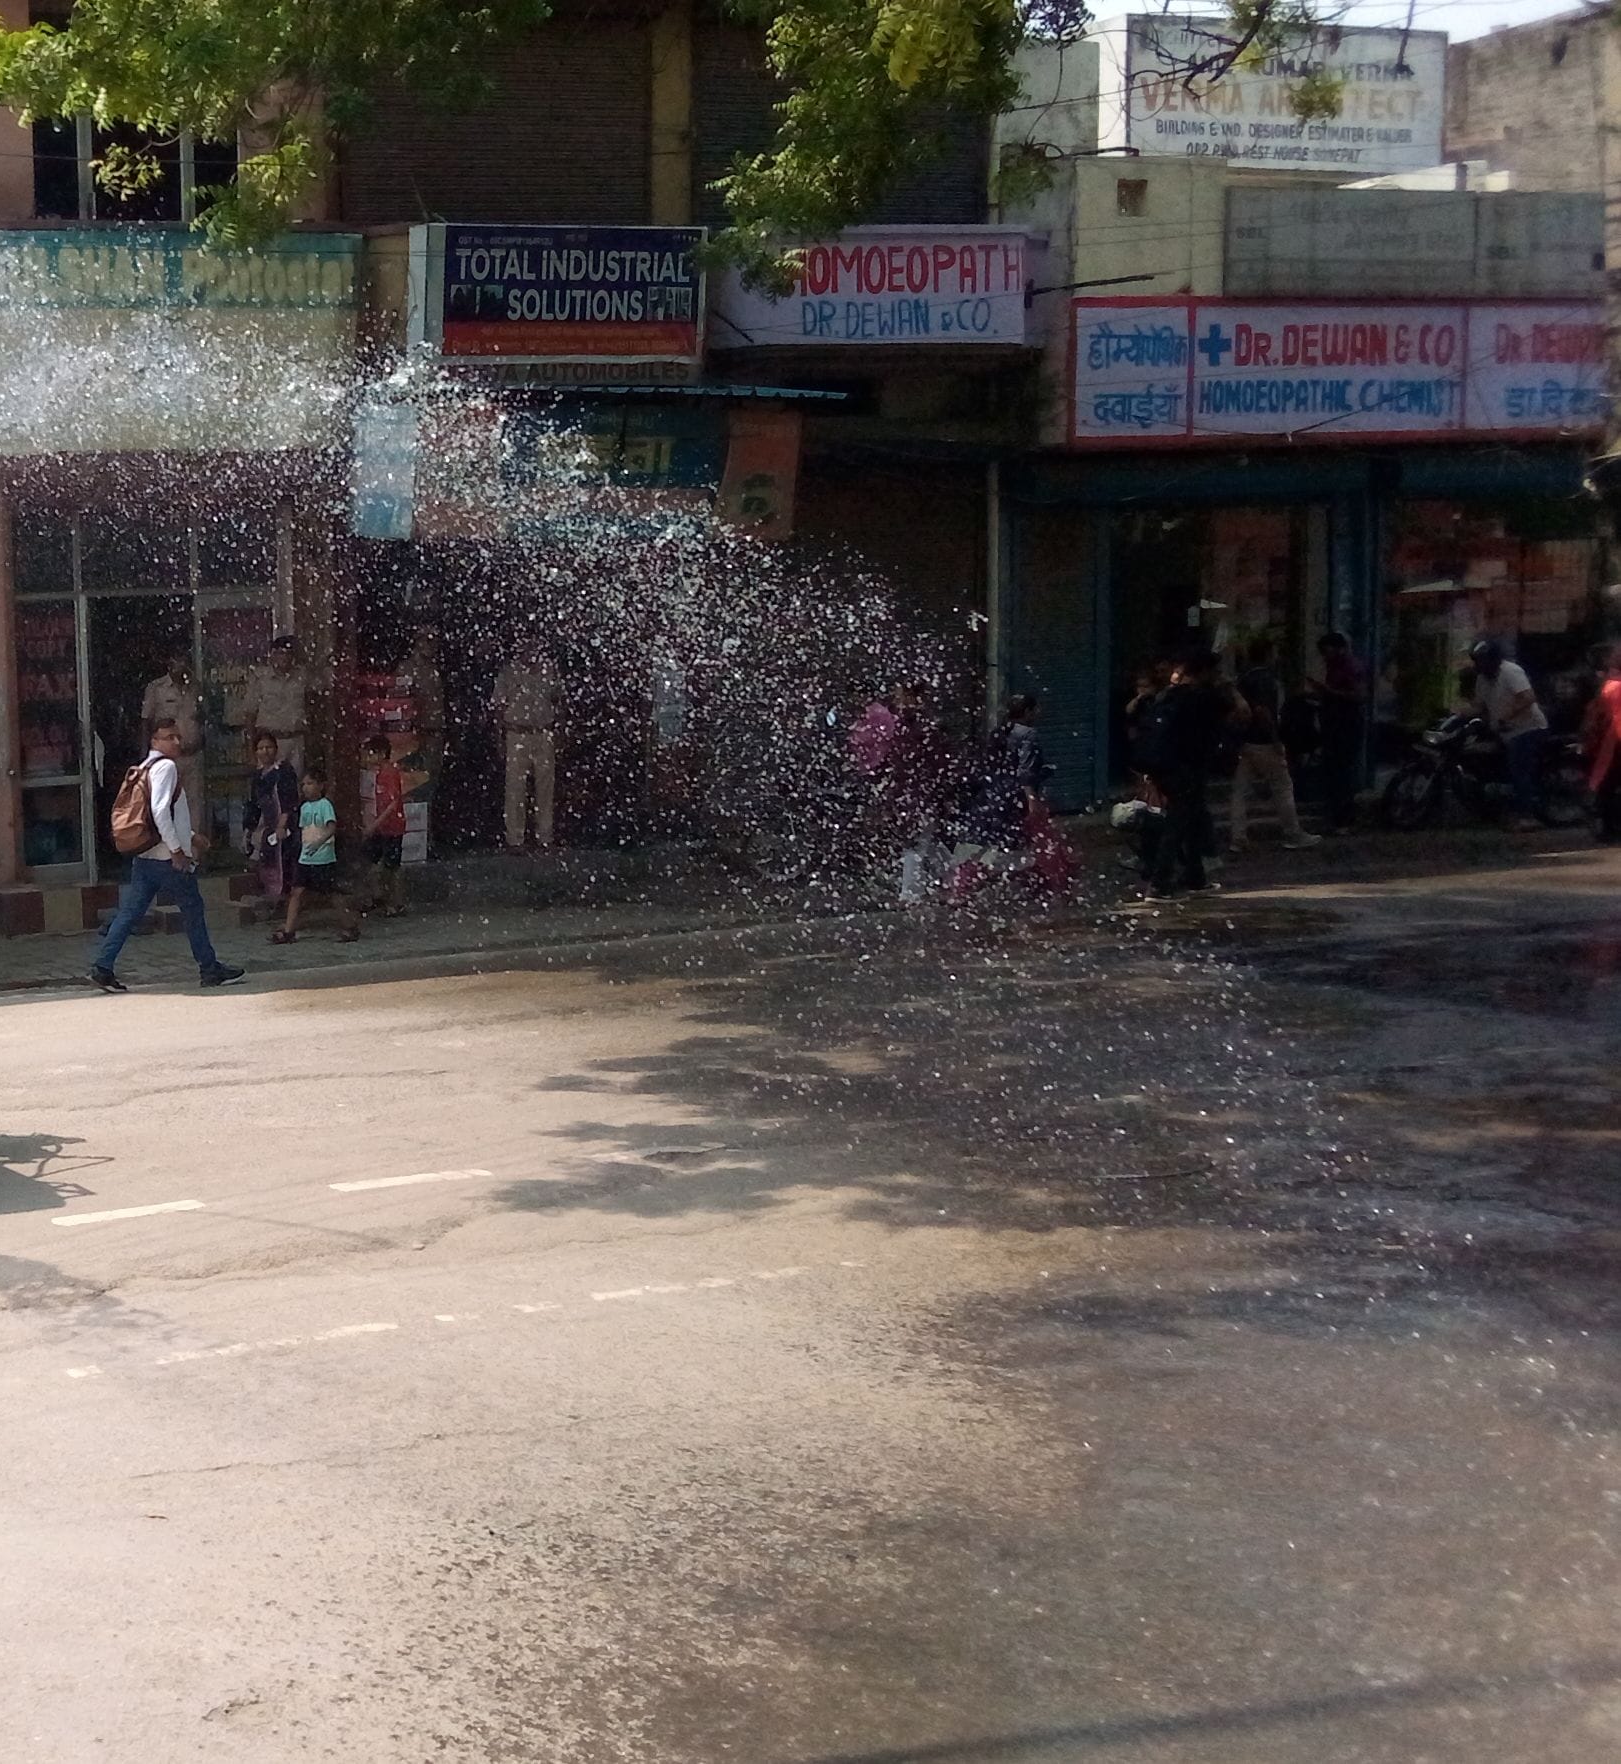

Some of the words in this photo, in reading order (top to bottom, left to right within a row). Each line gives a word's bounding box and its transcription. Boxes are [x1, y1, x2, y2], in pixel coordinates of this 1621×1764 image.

[1258, 82, 1422, 122] ARTECT
[456, 248, 536, 280] TOTAL
[541, 249, 691, 283] INDUSTRIAL
[506, 287, 643, 321] SOLUTIONS
[1418, 323, 1456, 367] CO
[1198, 379, 1353, 415] HOMOEOPATHIC
